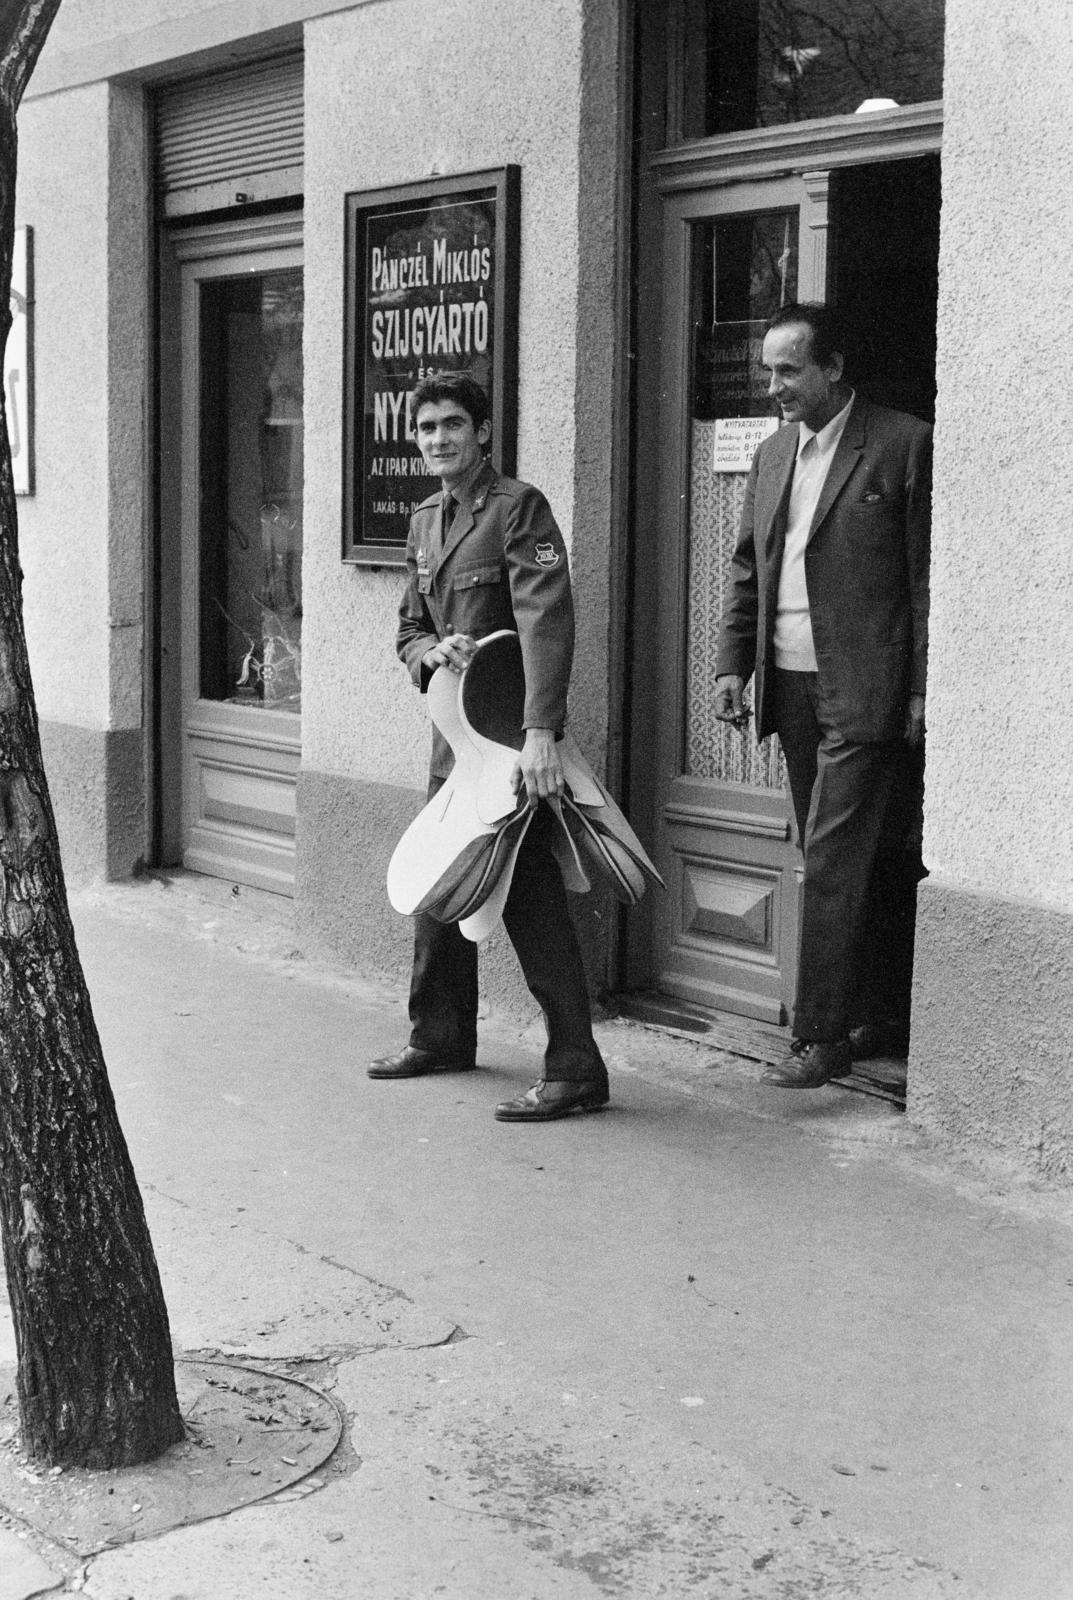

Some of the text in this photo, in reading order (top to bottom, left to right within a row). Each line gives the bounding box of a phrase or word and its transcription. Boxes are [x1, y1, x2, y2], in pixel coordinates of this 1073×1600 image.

[372, 286, 488, 358] SZIJGYÁRTÓ
[418, 358, 433, 379] ÉS
[374, 391, 417, 441] NYE
[386, 457, 408, 476] IPAR
